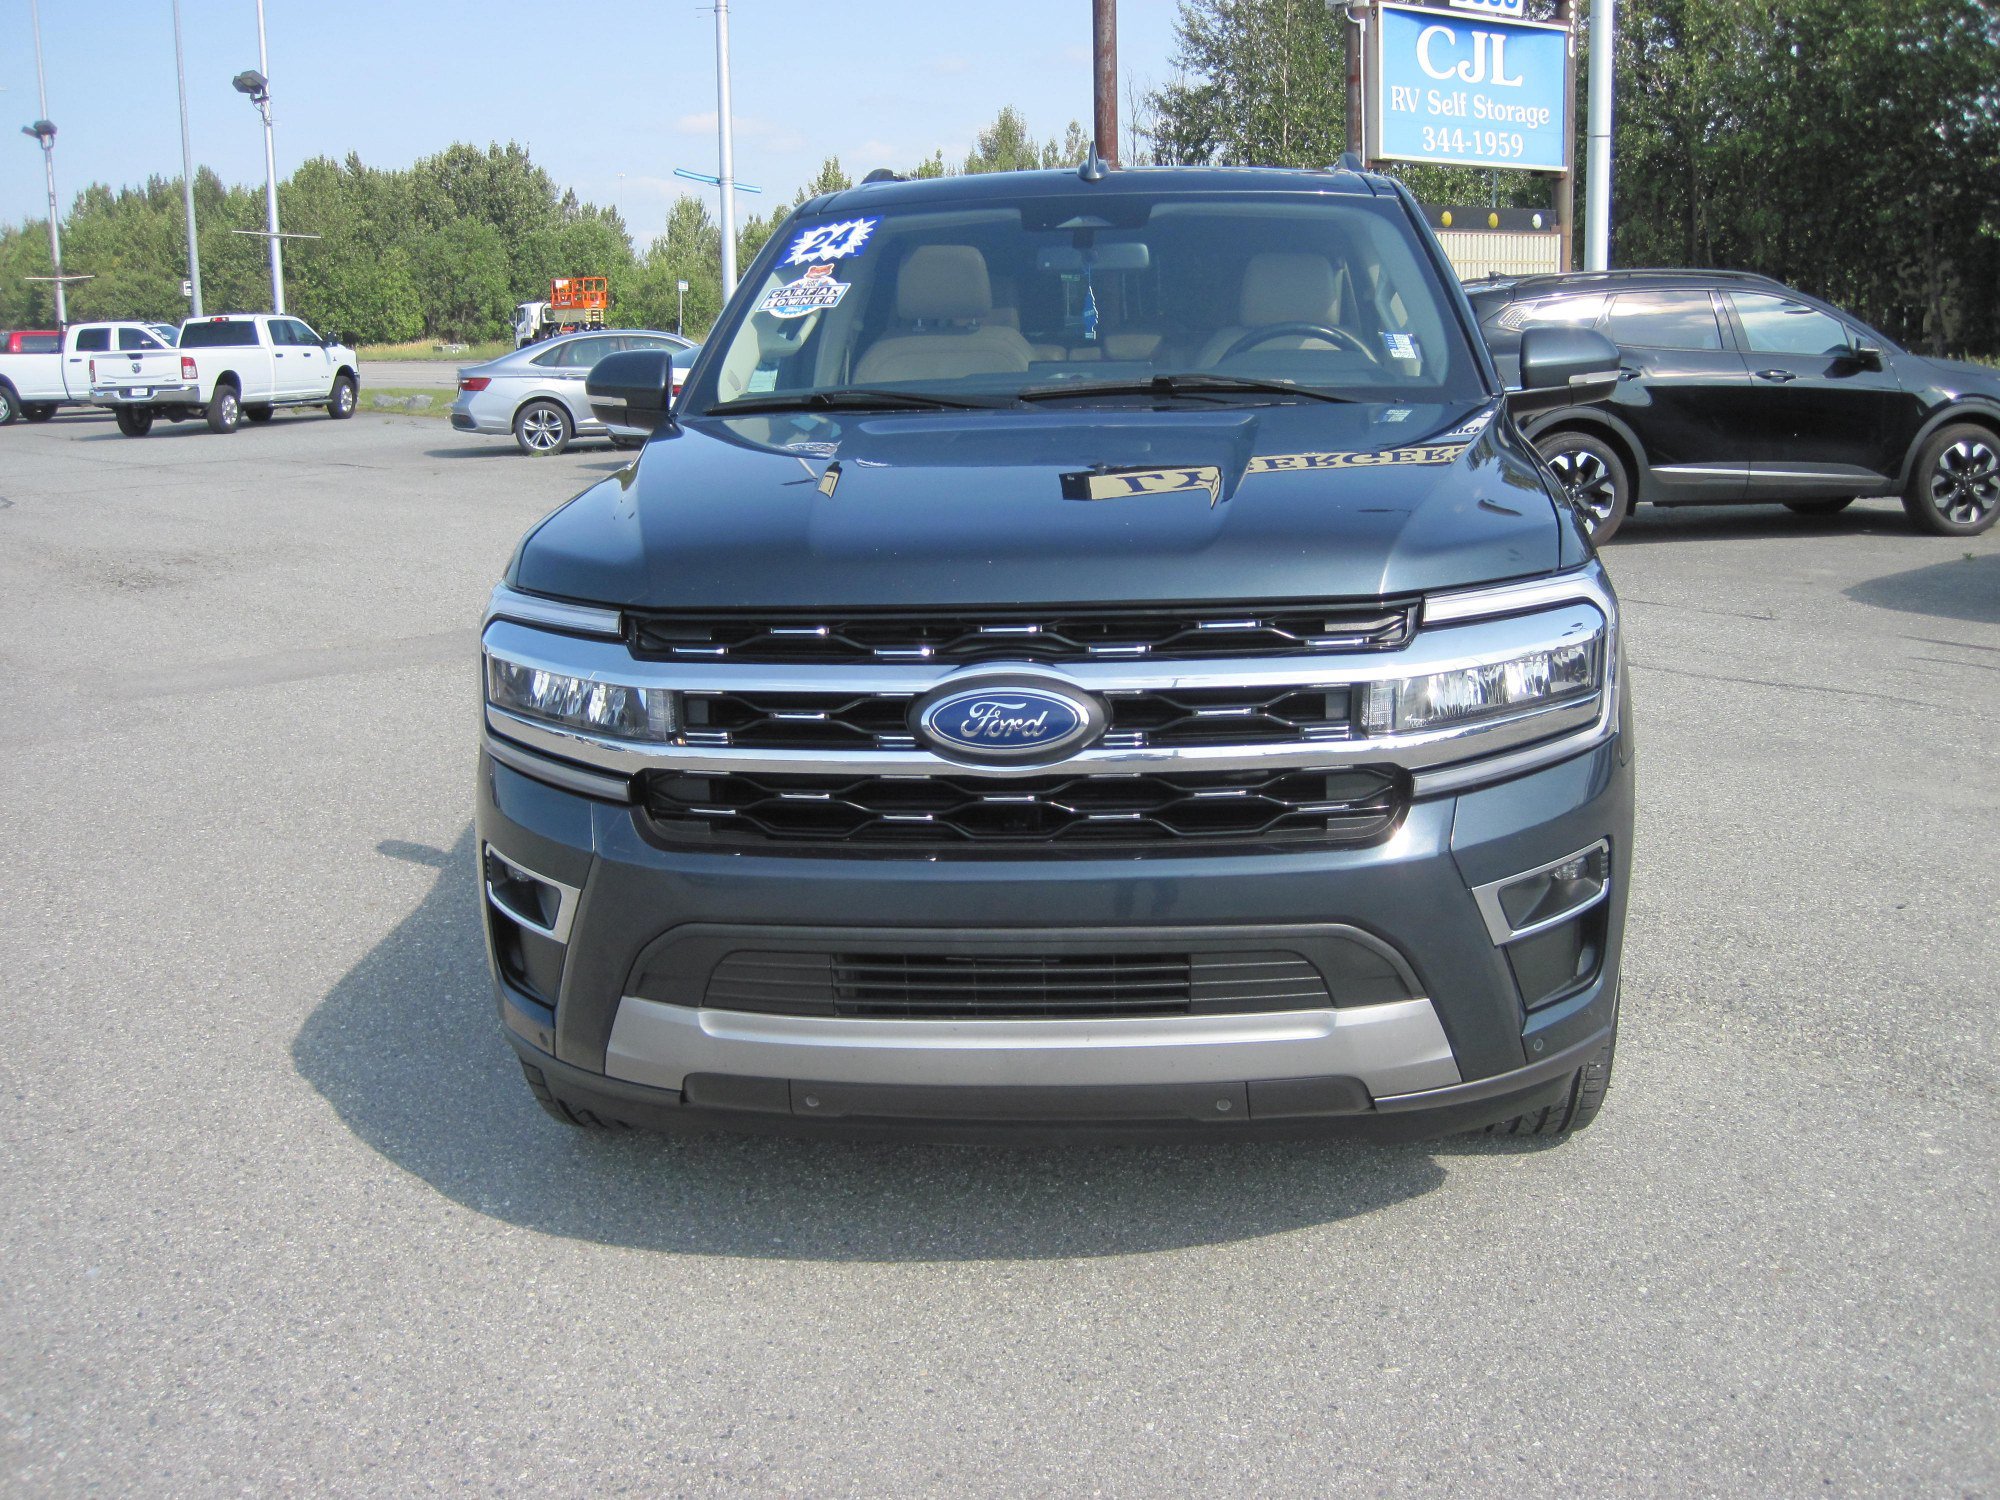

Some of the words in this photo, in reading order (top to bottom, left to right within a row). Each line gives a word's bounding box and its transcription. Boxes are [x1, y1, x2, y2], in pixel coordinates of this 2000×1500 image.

[1416, 25, 1523, 87] CJL
[1390, 85, 1420, 113] RV
[1427, 90, 1467, 117] Self
[1473, 94, 1550, 129] Storage
[1422, 126, 1524, 158] 344-1959
[801, 226, 856, 255] 24
[771, 287, 839, 298] CARFAX
[776, 296, 834, 306] OWNER
[960, 701, 1049, 738] Ford
